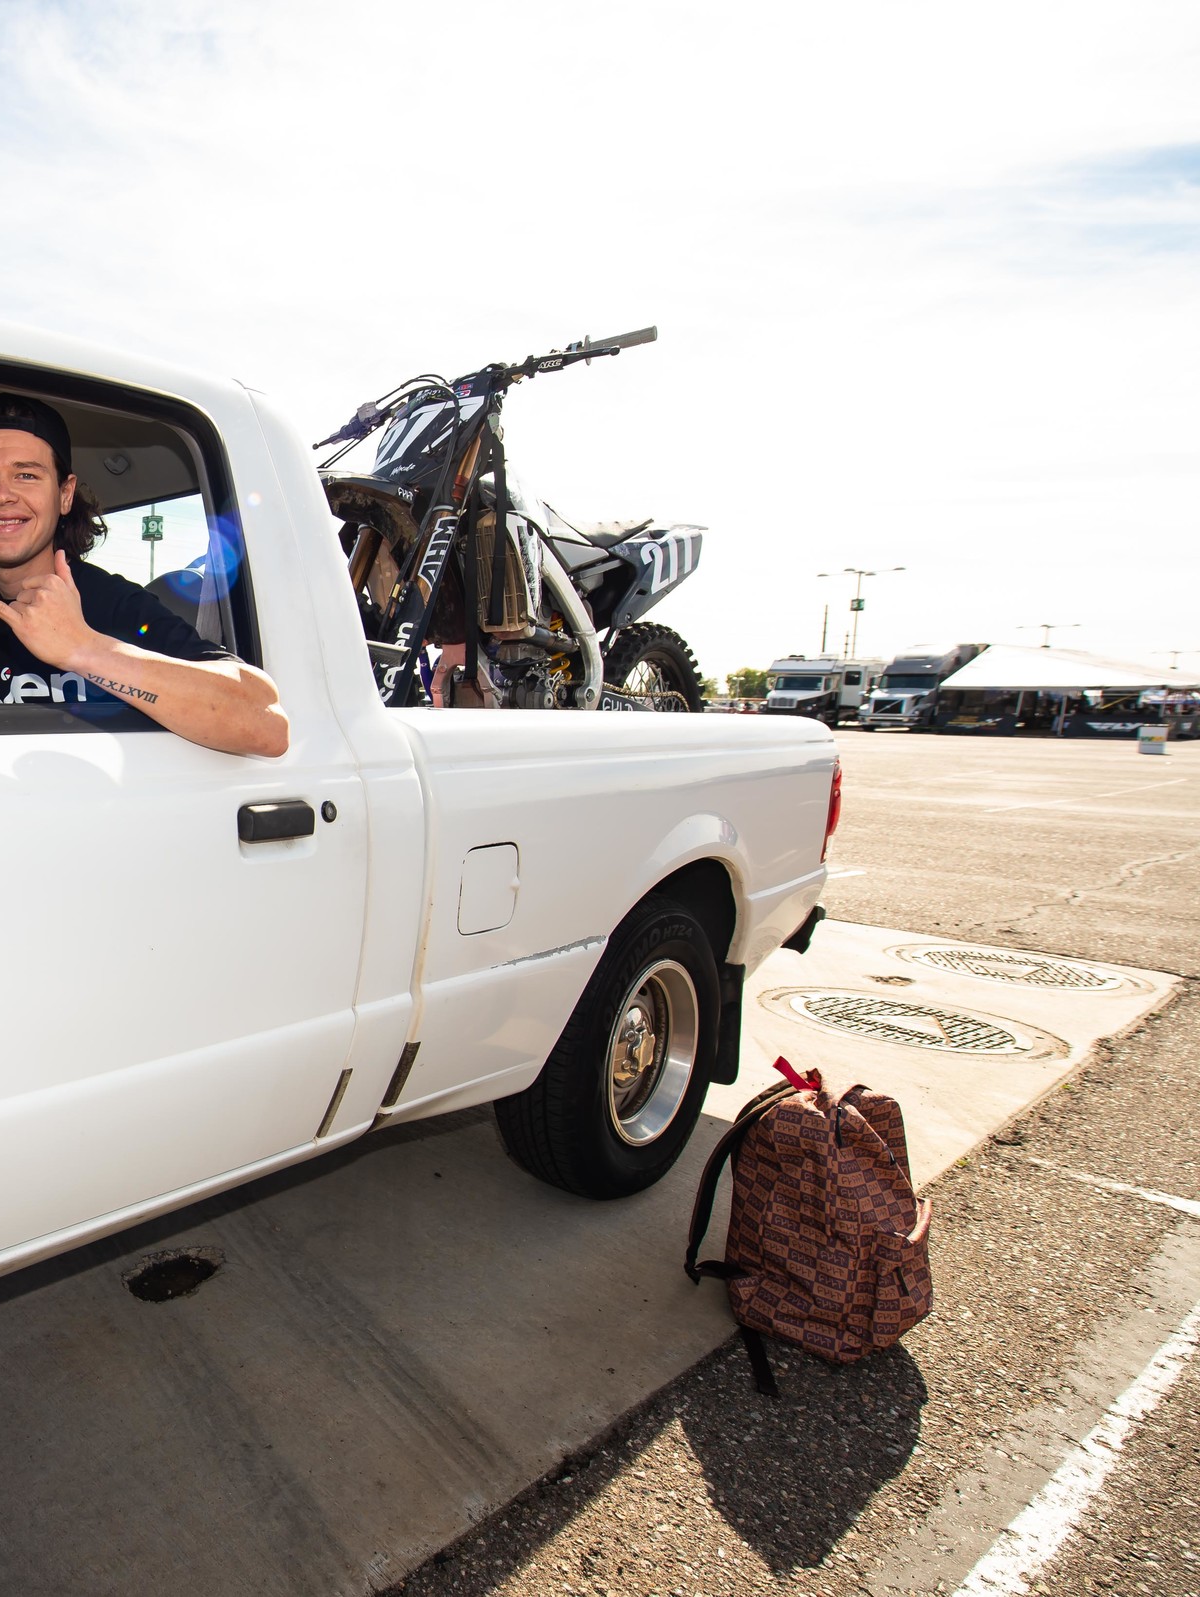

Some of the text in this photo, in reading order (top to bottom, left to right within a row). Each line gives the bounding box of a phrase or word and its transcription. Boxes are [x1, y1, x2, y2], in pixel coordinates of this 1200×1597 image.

[538, 358, 563, 370] ARC
[417, 516, 459, 592] AHM
[663, 924, 693, 940] H724
